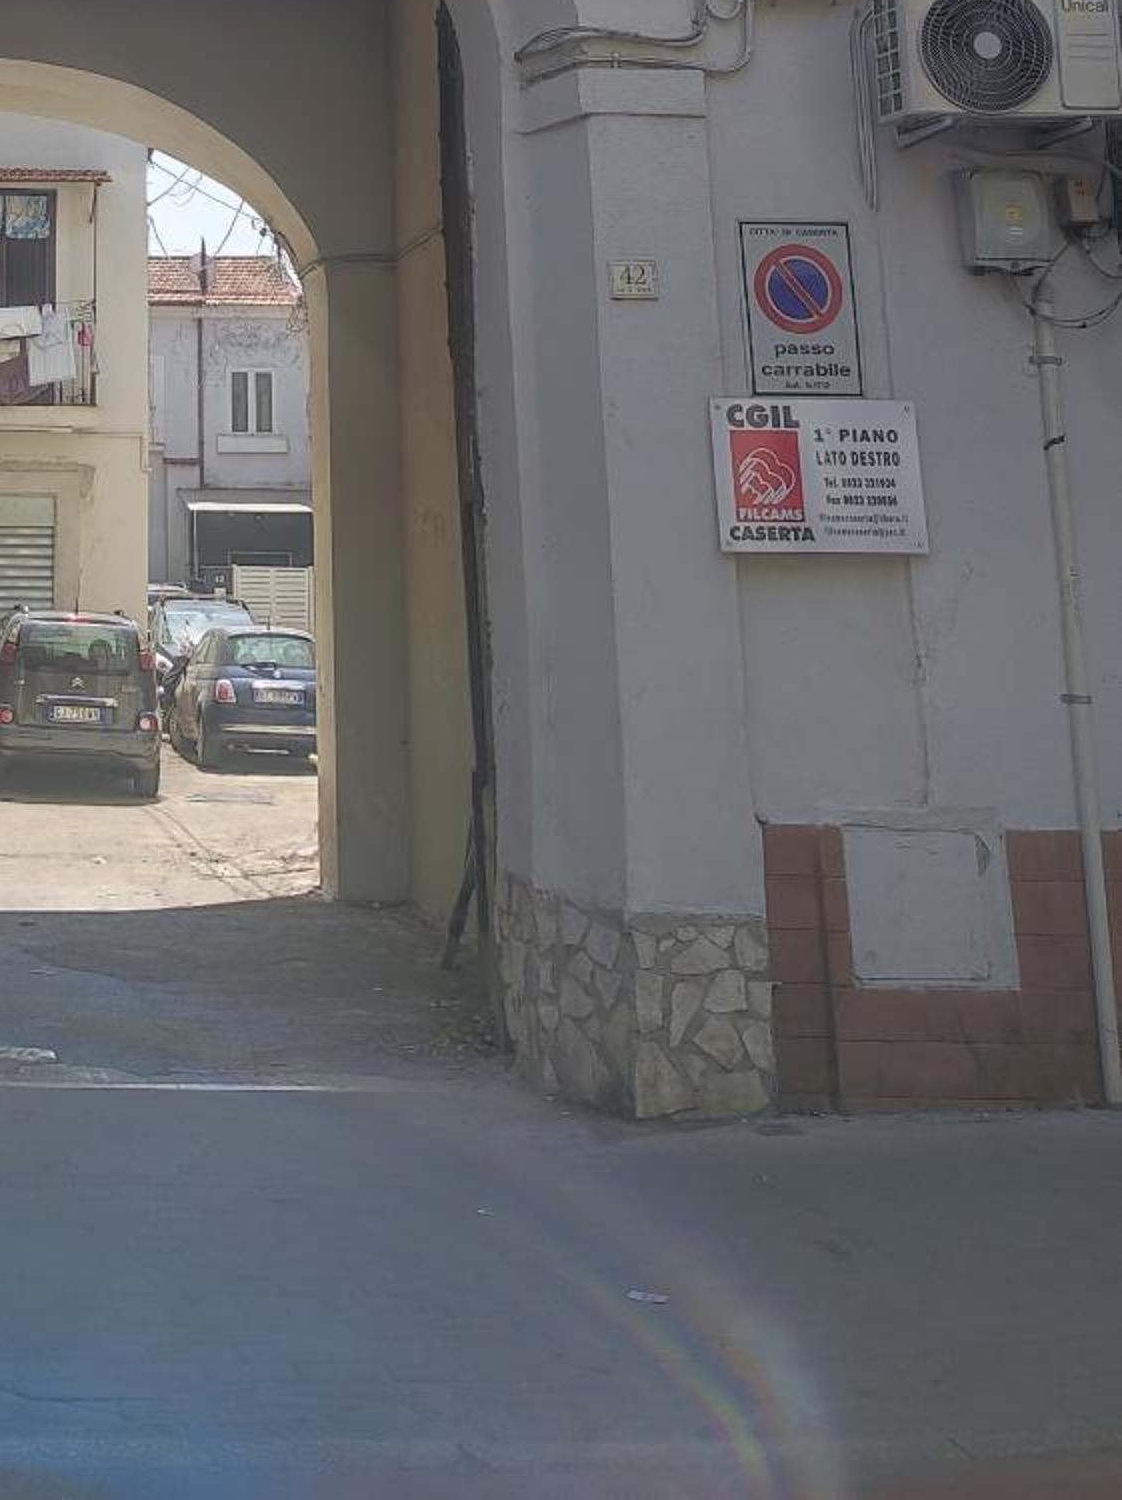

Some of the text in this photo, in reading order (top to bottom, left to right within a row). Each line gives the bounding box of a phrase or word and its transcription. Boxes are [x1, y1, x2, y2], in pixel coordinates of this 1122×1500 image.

[796, 228, 838, 237] CASERTA
[774, 343, 835, 359] passo
[761, 362, 851, 377] carrabile
[726, 404, 800, 428] CGIL
[839, 429, 899, 443] PIANO
[816, 451, 900, 467] LATO DESTRO
[738, 507, 803, 521] FILCAMS
[729, 526, 816, 542] CASERTA
